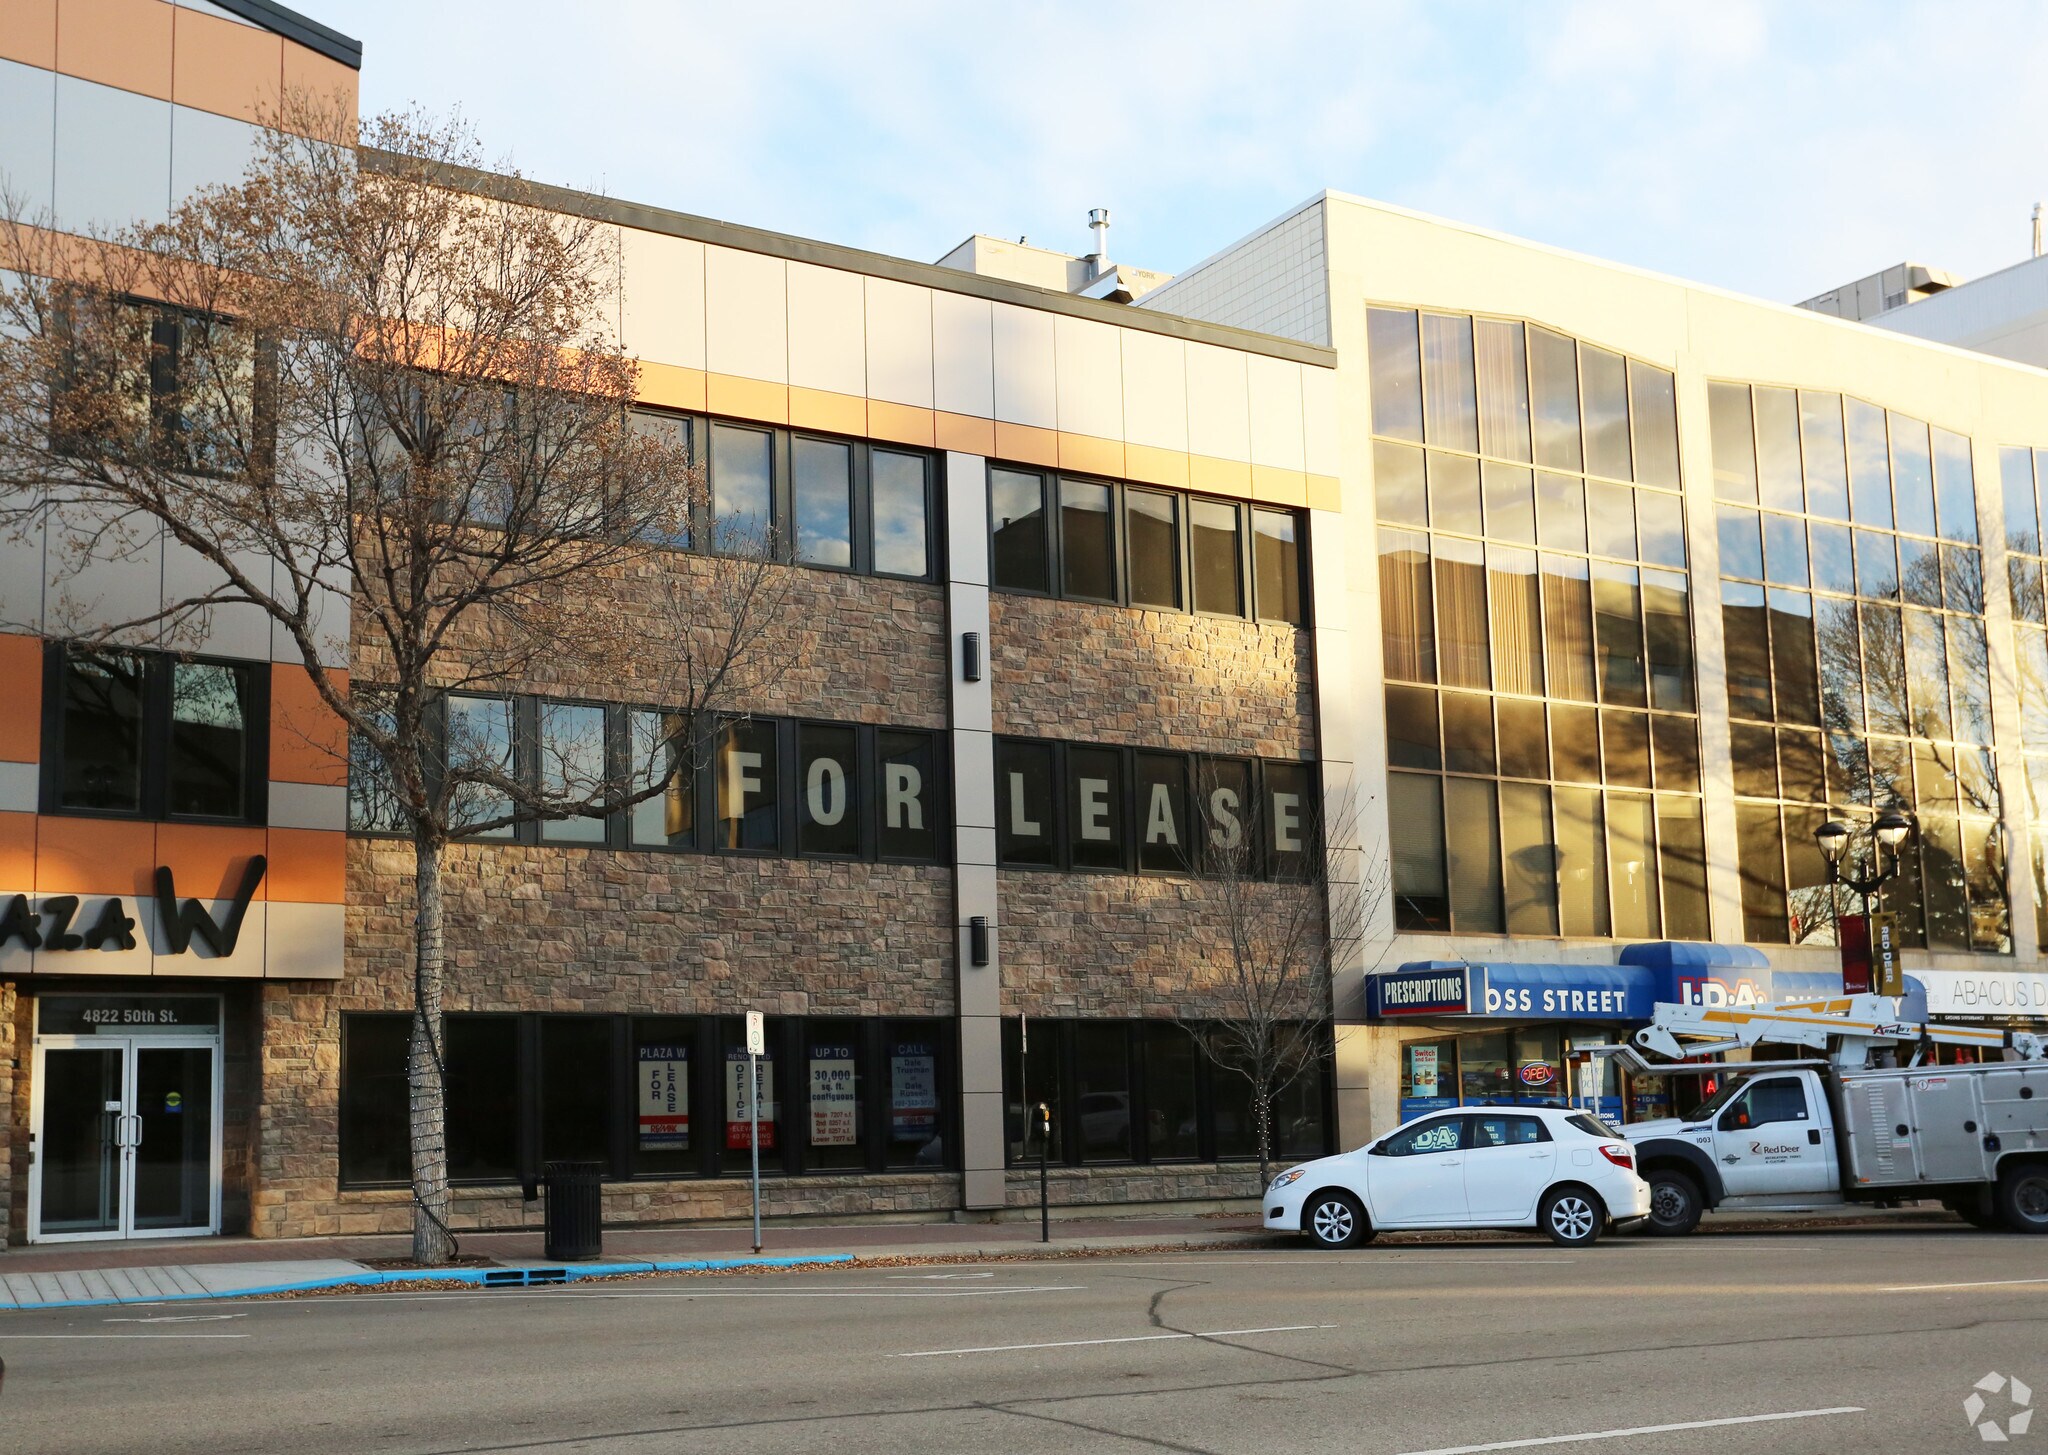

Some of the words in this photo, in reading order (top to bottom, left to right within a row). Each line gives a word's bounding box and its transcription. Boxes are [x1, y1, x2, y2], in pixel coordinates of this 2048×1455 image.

[728, 751, 924, 830] FOR
[1009, 772, 1302, 852] LEASE
[155, 854, 267, 957] W
[1881, 925, 1890, 950] RED
[1882, 952, 1894, 983] DEER
[1385, 976, 1462, 1005] PRESCRIPTIONS
[1953, 979, 2028, 1006] ABACUS
[2033, 981, 2048, 1006] D
[1486, 988, 1532, 1012] OSS
[1543, 989, 1625, 1013] STREET
[82, 1009, 119, 1023] 4822
[123, 1009, 155, 1023] 50th
[159, 1009, 178, 1023] St.
[640, 1047, 673, 1058] PLAZA
[676, 1047, 686, 1058] W
[815, 1048, 830, 1058] UP
[834, 1048, 849, 1057] TO
[897, 1044, 926, 1055] CALL
[1414, 1049, 1436, 1057] Switch
[904, 1059, 921, 1067] Dale
[815, 1070, 850, 1083] 30,000
[1523, 1066, 1552, 1081] OPEN
[651, 1070, 661, 1100] FOR
[667, 1062, 676, 1113] LEASE
[736, 1064, 745, 1119] OFFICE
[755, 1064, 764, 1118] RETAIL
[821, 1083, 833, 1092] sq.
[835, 1082, 845, 1091] ft.
[905, 1082, 922, 1090] Dale
[812, 1092, 854, 1102] contiguous
[650, 1124, 677, 1134] RE/MAX
[1696, 1136, 1711, 1144] 1003
[1764, 1145, 1779, 1154] Red
[1780, 1144, 1800, 1153] Deer
